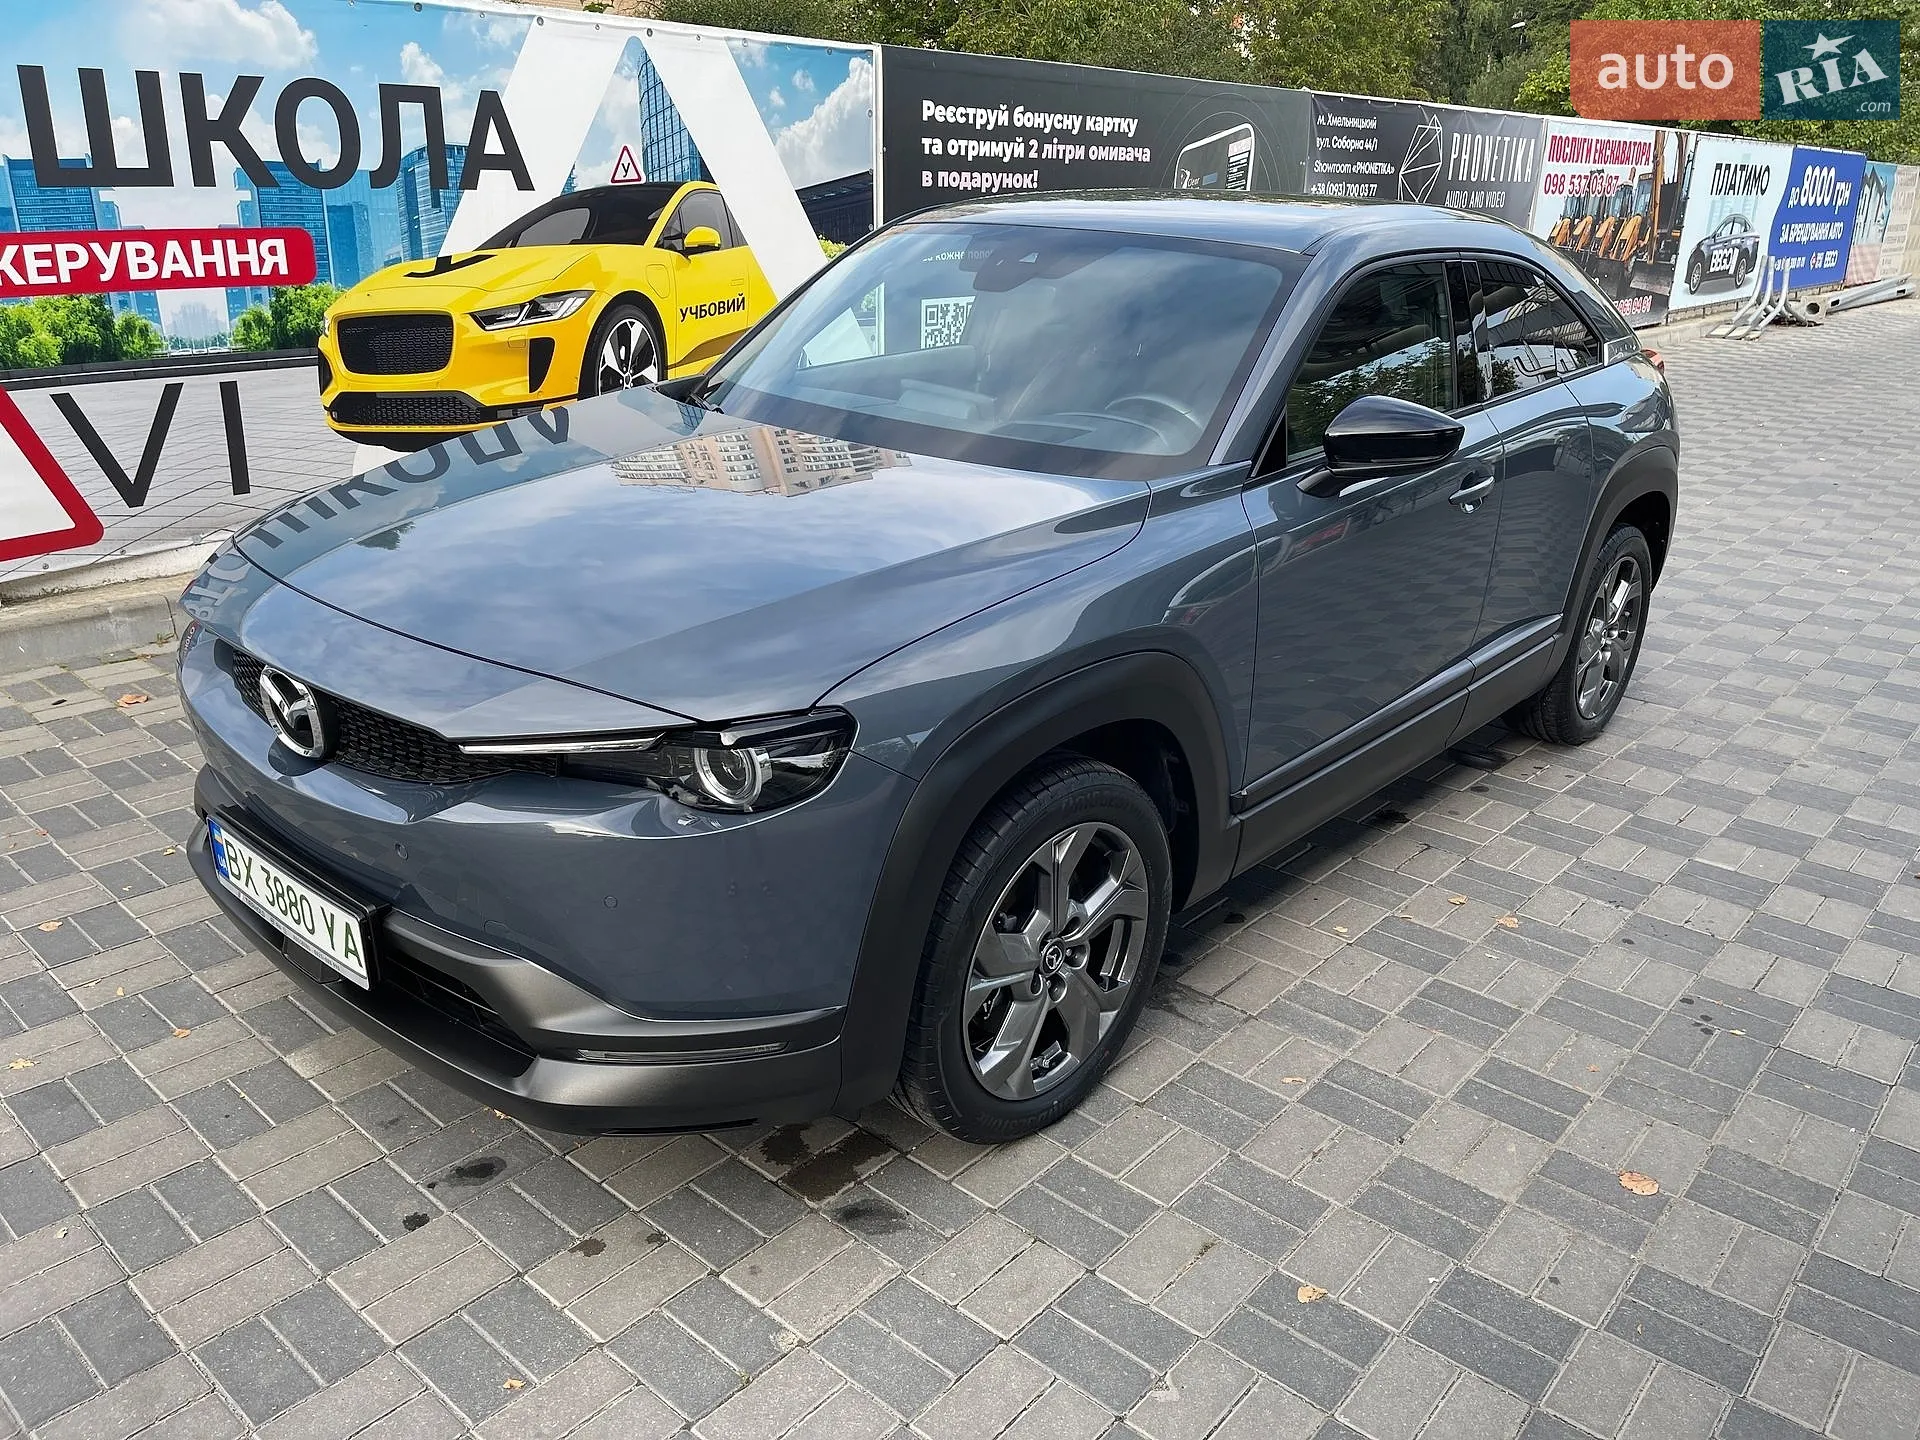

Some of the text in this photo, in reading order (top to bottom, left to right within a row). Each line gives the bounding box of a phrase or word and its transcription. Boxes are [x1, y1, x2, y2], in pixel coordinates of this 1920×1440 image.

[16, 64, 534, 191] ШКОЛА
[921, 99, 1139, 138] Реєструй бонусну картку
[1317, 113, 1377, 130] м. Хмельницький
[921, 132, 1151, 164] та отримуй 2 літри омивача
[1332, 136, 1364, 152] Соборна
[1364, 137, 1378, 151] 44/1
[1447, 133, 1536, 183] PHONETIKA
[1548, 135, 1652, 166] ПОСЛУГИ ЕКСКАВАТОРА
[921, 170, 1039, 194] в подарунок!
[1314, 160, 1351, 174] Showroom
[1710, 162, 1771, 197] ПЛАТИМО
[1326, 181, 1345, 196] (093)
[1347, 184, 1359, 197] 700
[1360, 184, 1369, 197] 03
[1369, 184, 1378, 196] 77
[1445, 191, 1506, 208] AUDIO AND VIDEO
[1544, 173, 1620, 196] 098 537 03 87
[1801, 165, 1836, 207] 8000
[1833, 181, 1852, 215] грн
[0, 239, 289, 287] КЕРУВАННЯ
[680, 293, 746, 323] УЧБОВИЙ
[224, 838, 363, 969] BX 3880 YA
